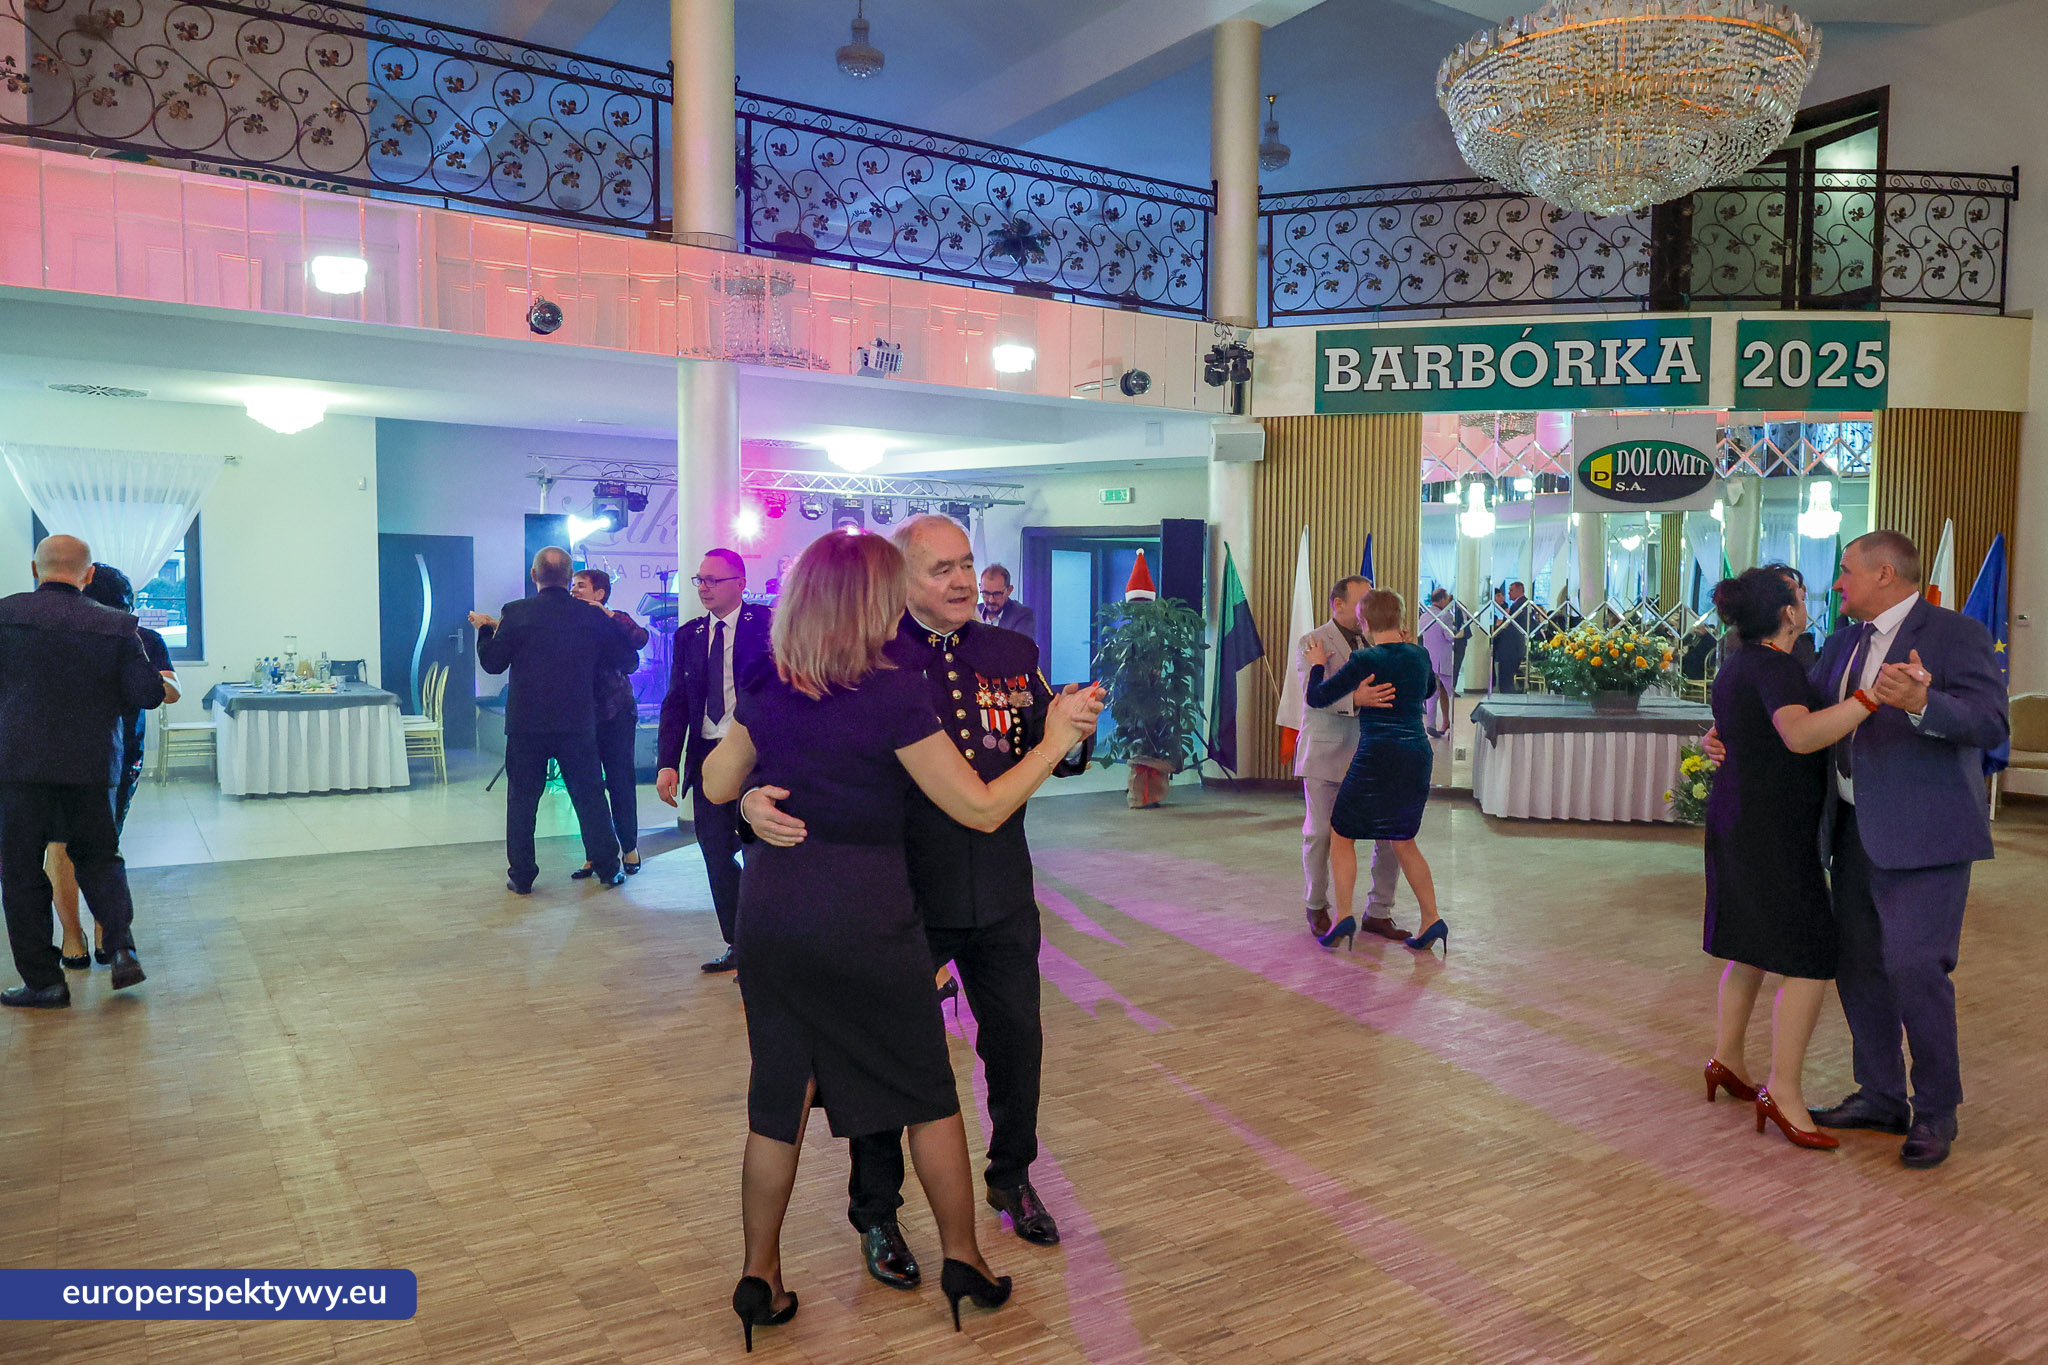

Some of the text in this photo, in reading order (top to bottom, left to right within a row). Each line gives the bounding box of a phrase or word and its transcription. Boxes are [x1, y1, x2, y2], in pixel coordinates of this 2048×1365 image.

[1323, 327, 1886, 392] BARBÓRKA 2025
[1616, 447, 1709, 476] DOLOMIT
[1615, 481, 1646, 492] S.A.
